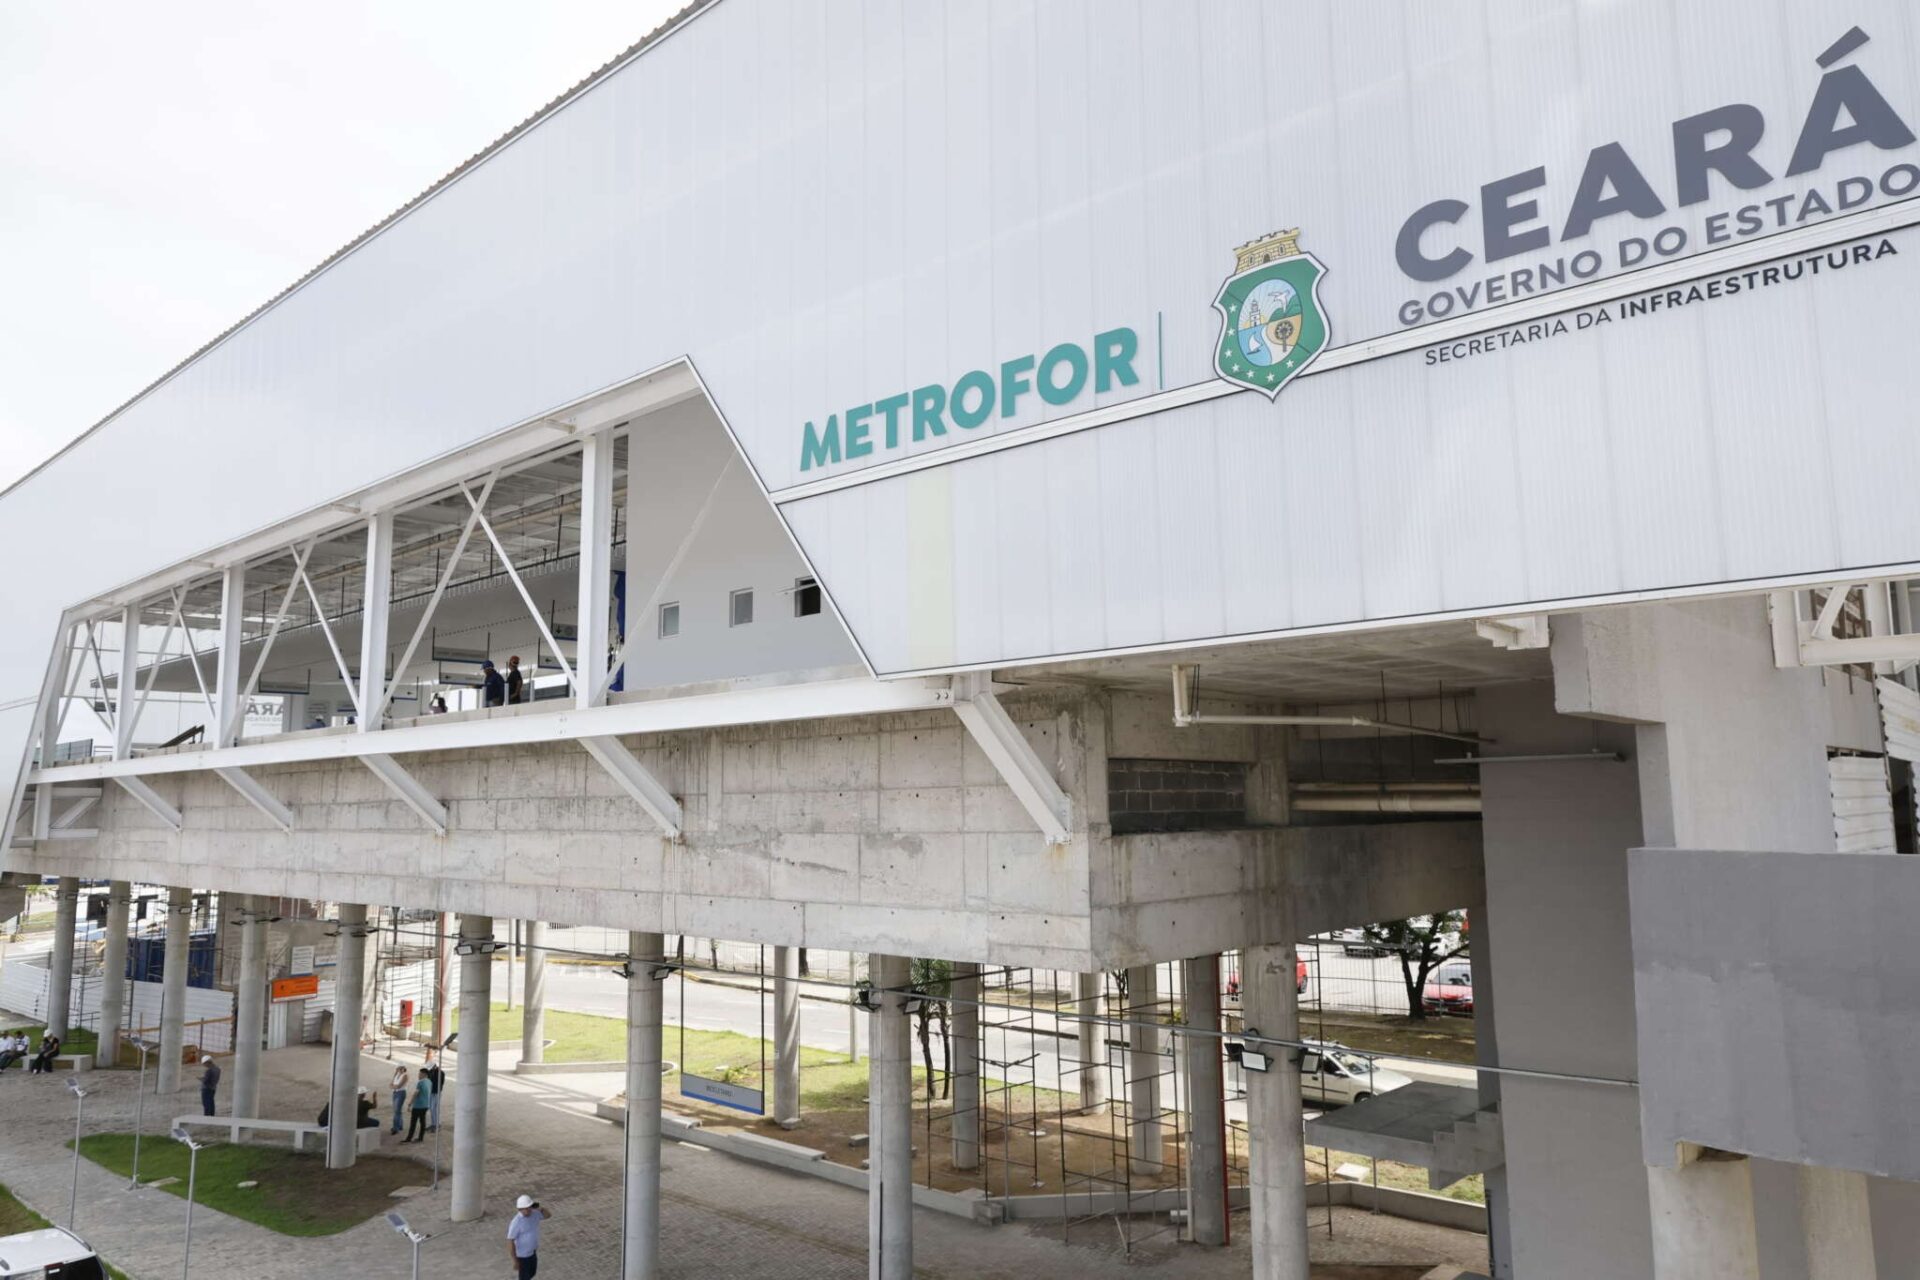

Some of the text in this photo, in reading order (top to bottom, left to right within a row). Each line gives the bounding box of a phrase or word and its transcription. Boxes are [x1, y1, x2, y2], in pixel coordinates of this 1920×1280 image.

[1394, 25, 1918, 283] CEARÁ
[1398, 163, 1920, 327] GOVERNO DO ESTADO
[1425, 238, 1900, 366] SECRETARIA DA INFRAESTRUTURA
[799, 327, 1140, 472] METROFOR
